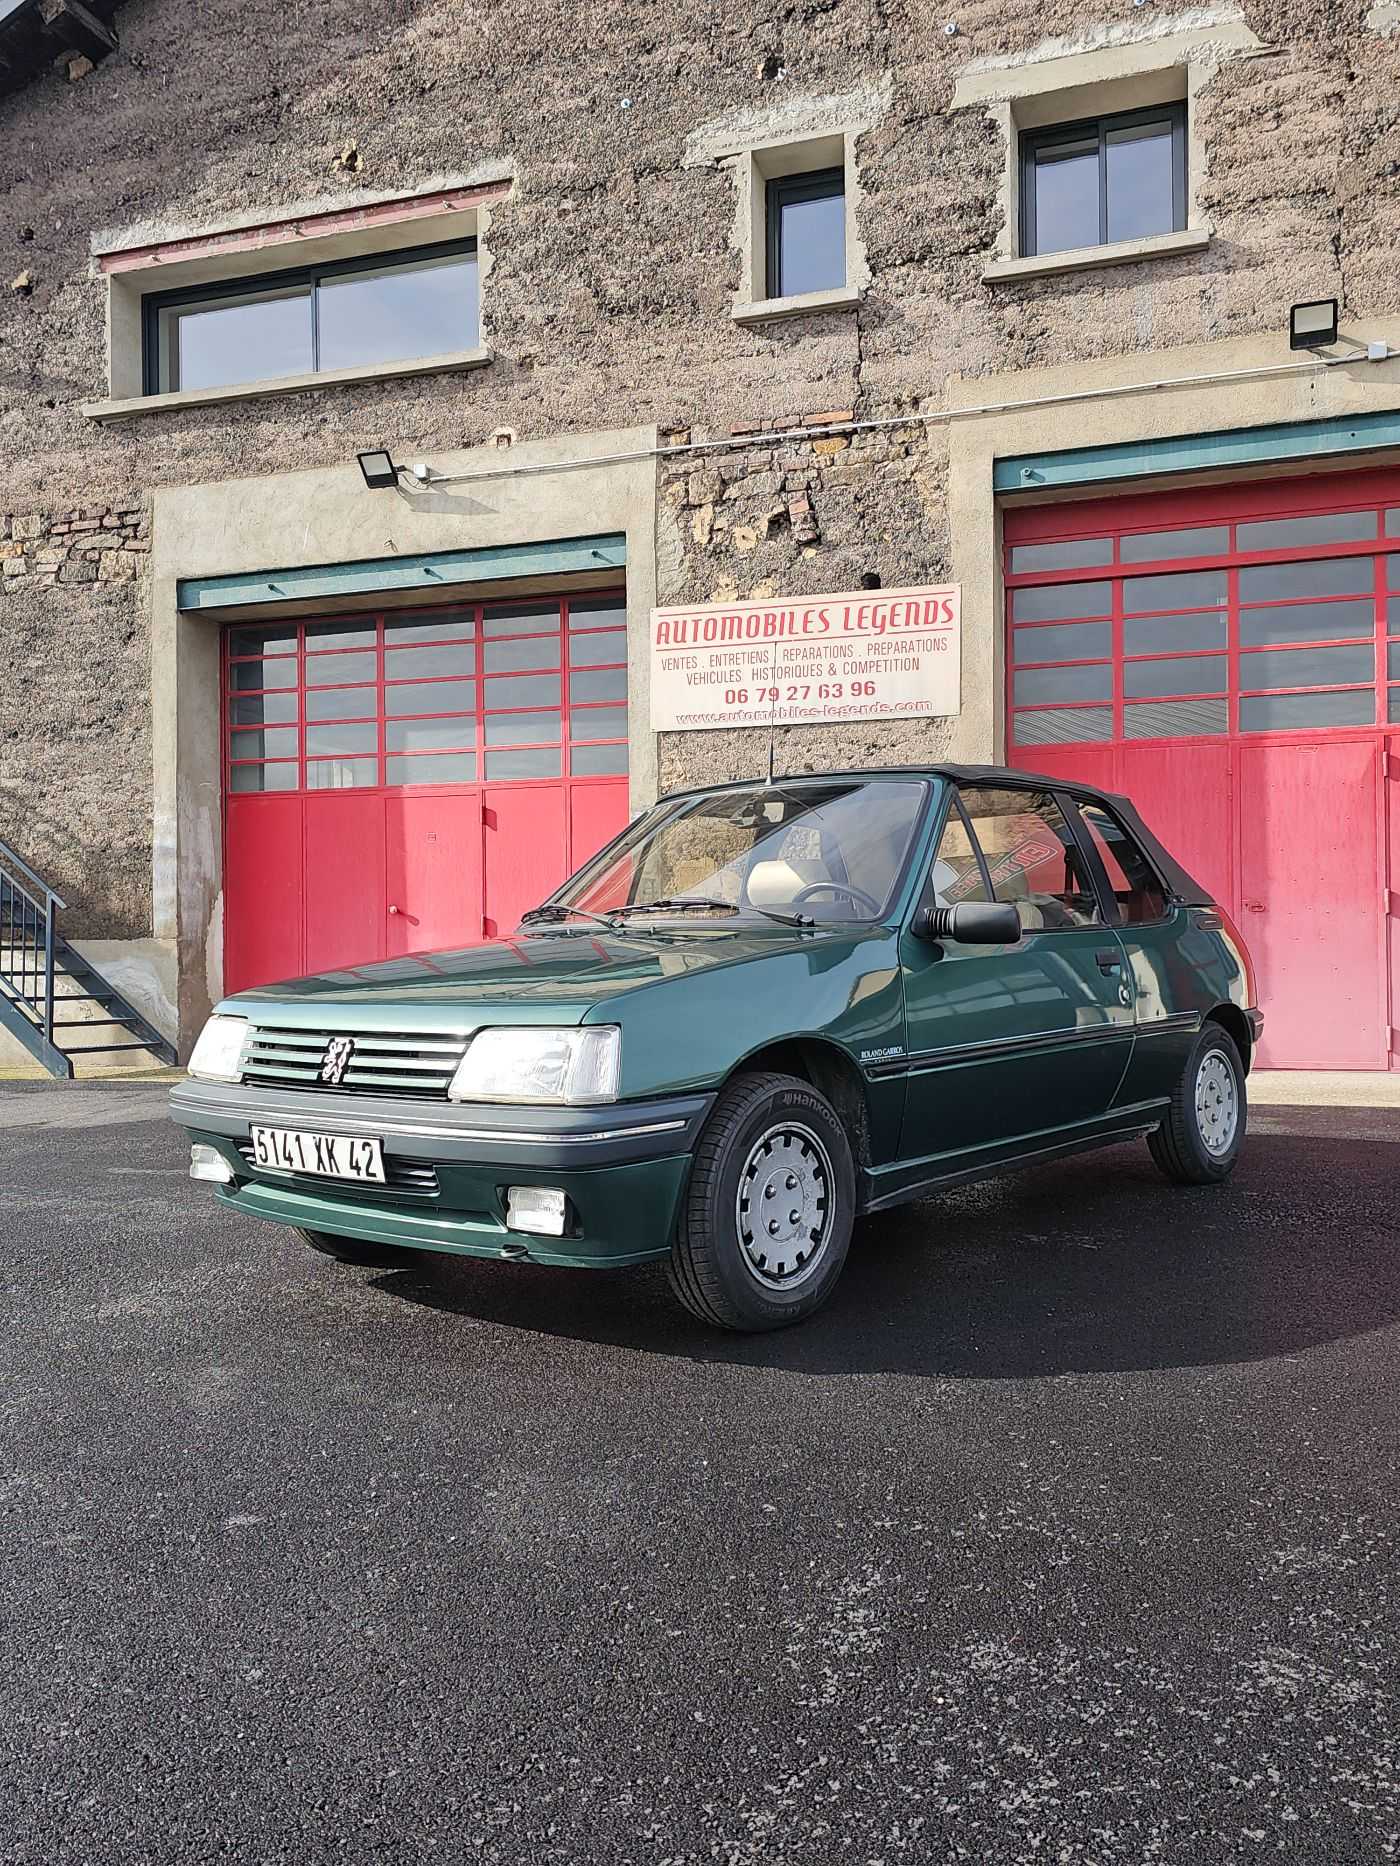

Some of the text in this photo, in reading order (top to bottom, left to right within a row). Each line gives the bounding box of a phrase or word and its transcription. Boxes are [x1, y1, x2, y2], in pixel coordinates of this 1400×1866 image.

[656, 598, 954, 645] AUTOMOBILES LEGENDS
[661, 637, 948, 671] VENTES ENTRETIENS REPARATIONS PREPARATIONS
[686, 657, 921, 686] VEHICULES HISTORIQUES & COMPETITION
[725, 680, 876, 704] 06 79 27 63 96
[675, 698, 933, 725] www.automobiles-legends.com
[257, 1129, 377, 1178] 5141 XK 42
